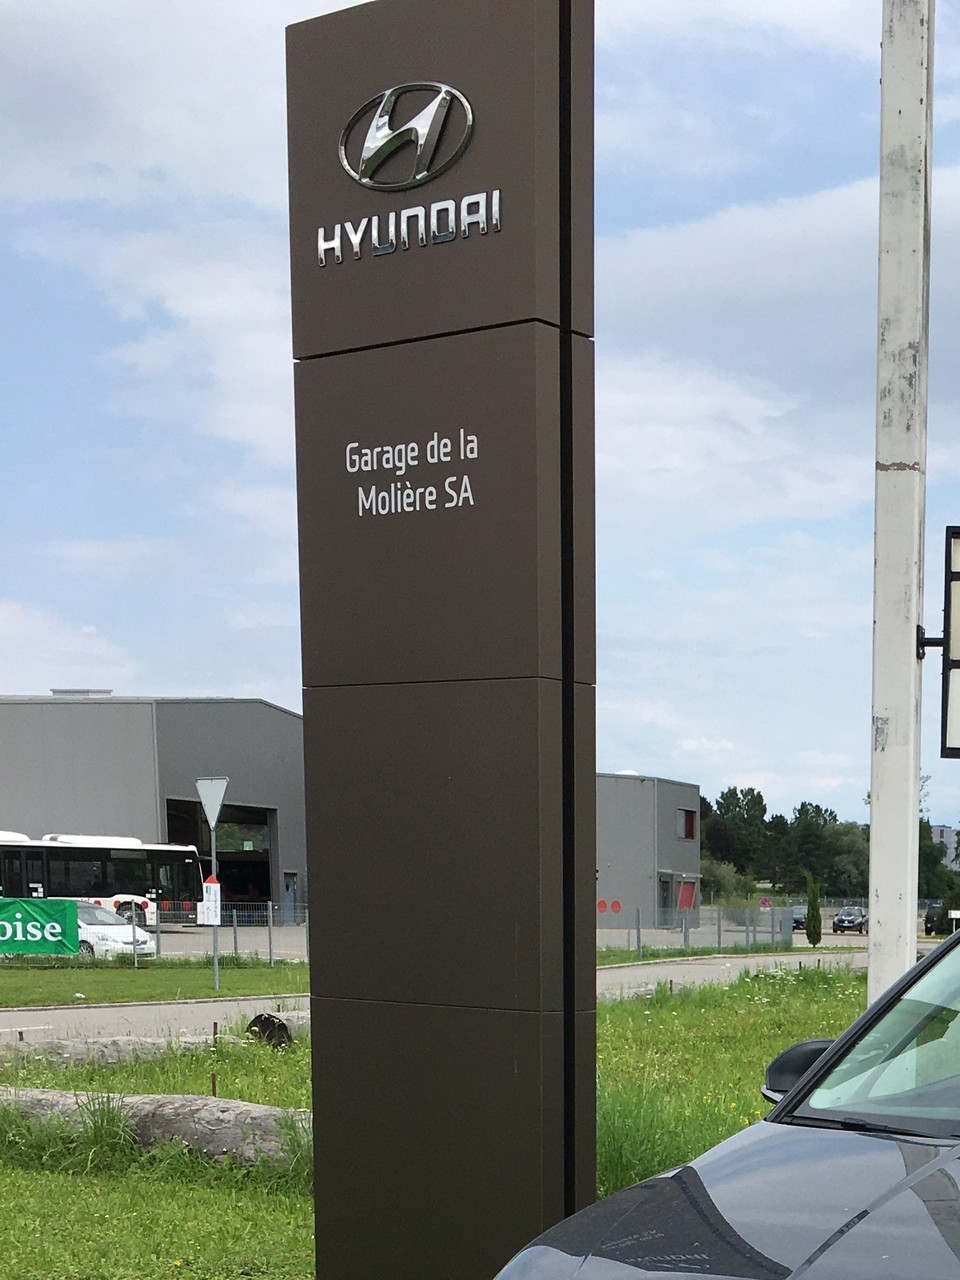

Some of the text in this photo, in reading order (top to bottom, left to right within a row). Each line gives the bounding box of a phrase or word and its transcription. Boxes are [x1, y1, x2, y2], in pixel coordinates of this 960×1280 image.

[317, 189, 501, 267] HYUNDAI
[345, 427, 479, 476] Garage de la
[357, 474, 475, 517] Molière SA
